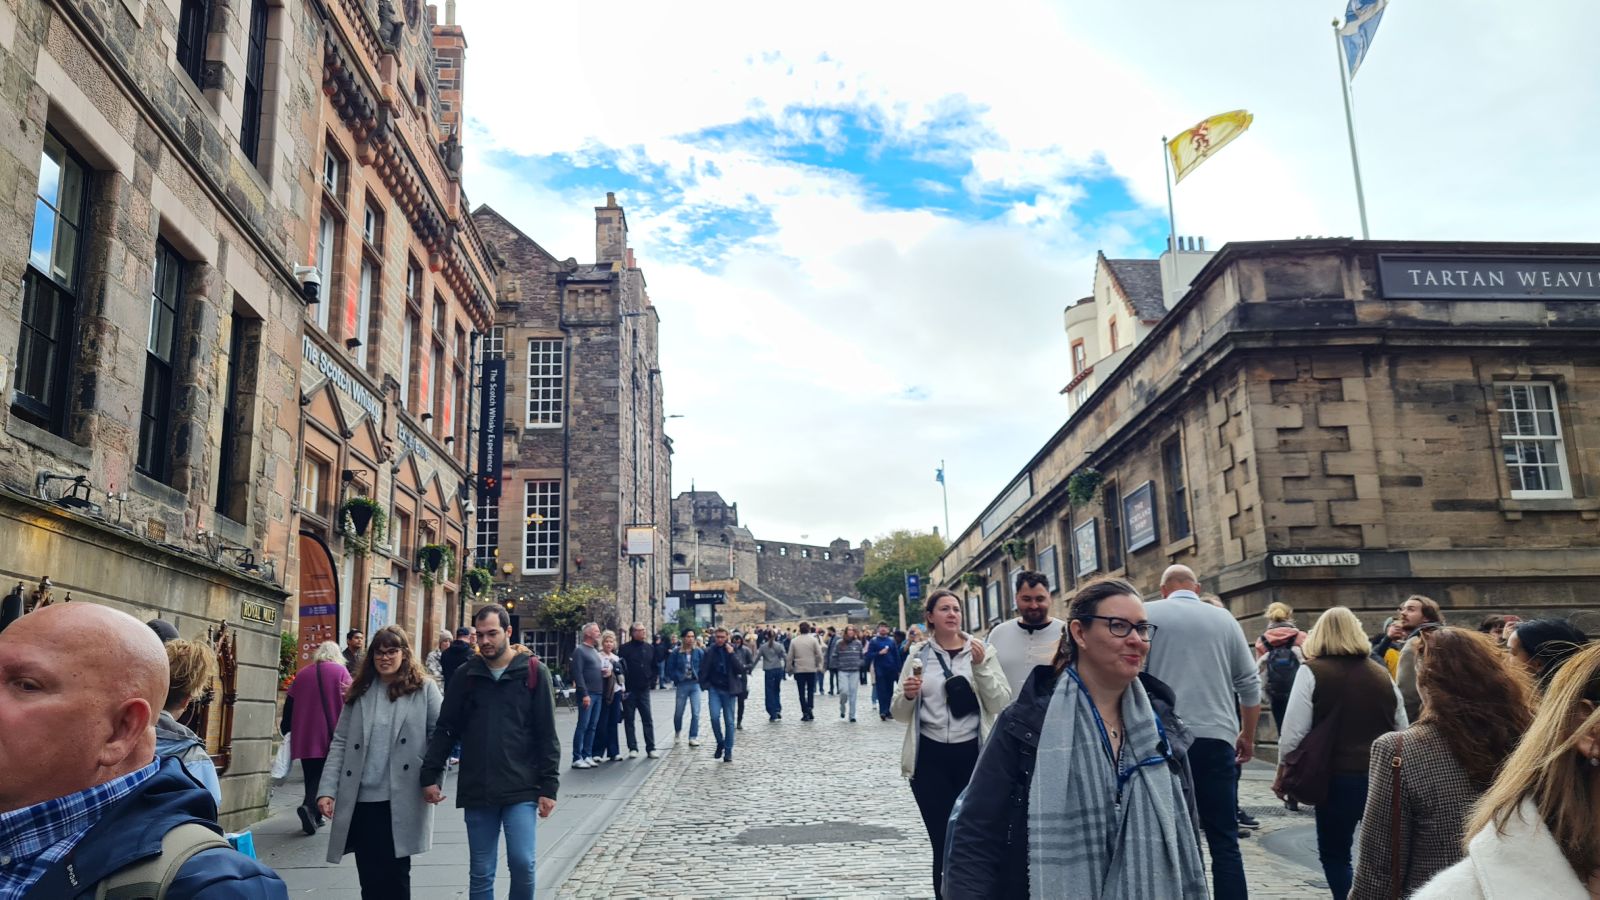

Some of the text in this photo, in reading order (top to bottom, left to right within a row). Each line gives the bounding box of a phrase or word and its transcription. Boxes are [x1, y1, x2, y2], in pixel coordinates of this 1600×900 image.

[1407, 269, 1600, 288] TARTAN WEAVI
[319, 352, 352, 395] Scotch
[352, 380, 381, 425] Whisky
[486, 369, 498, 473] The Scotch Whisky Experience
[1276, 553, 1356, 566] RAMSAY LANE
[243, 602, 276, 623] ROYAL MILE
